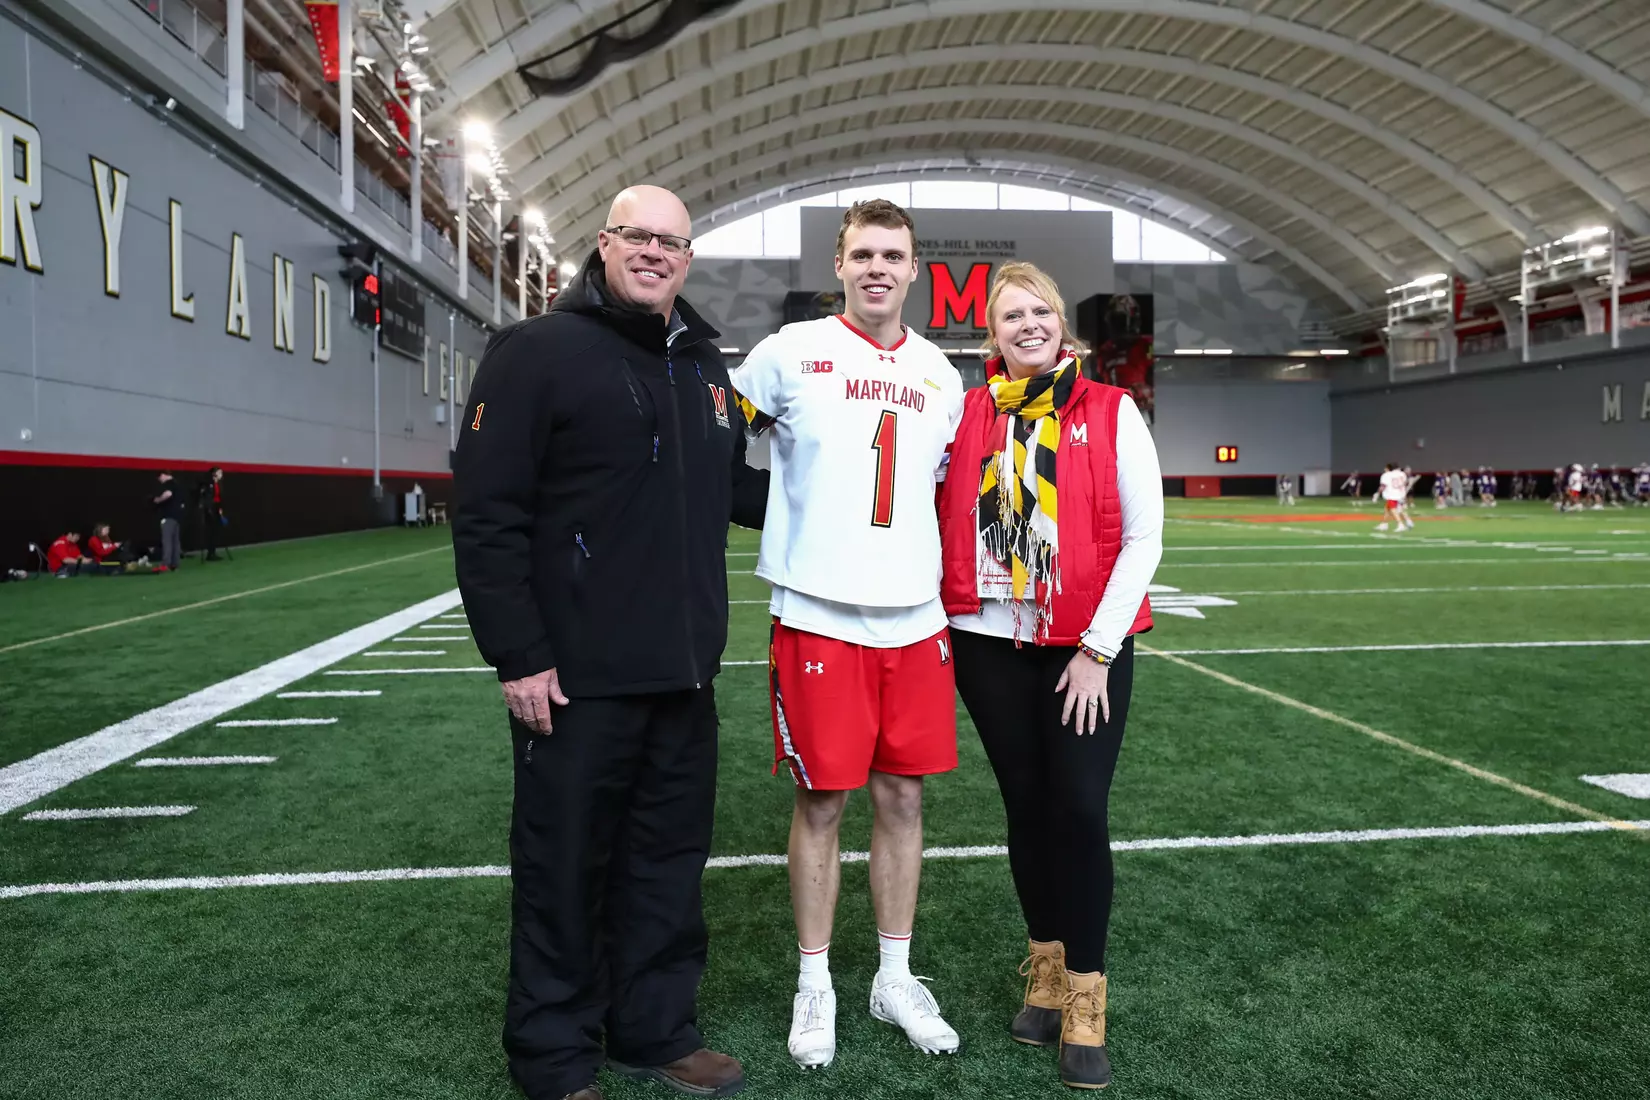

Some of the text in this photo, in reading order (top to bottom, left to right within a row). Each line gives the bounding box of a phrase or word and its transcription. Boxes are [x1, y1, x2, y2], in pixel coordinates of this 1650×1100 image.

[975, 240, 1016, 249] HOUSE
[926, 262, 992, 330] M
[708, 383, 729, 419] M
[845, 378, 926, 413] MARYLAND
[471, 402, 485, 431] 1
[1069, 422, 1088, 443] M
[870, 409, 898, 528] 1
